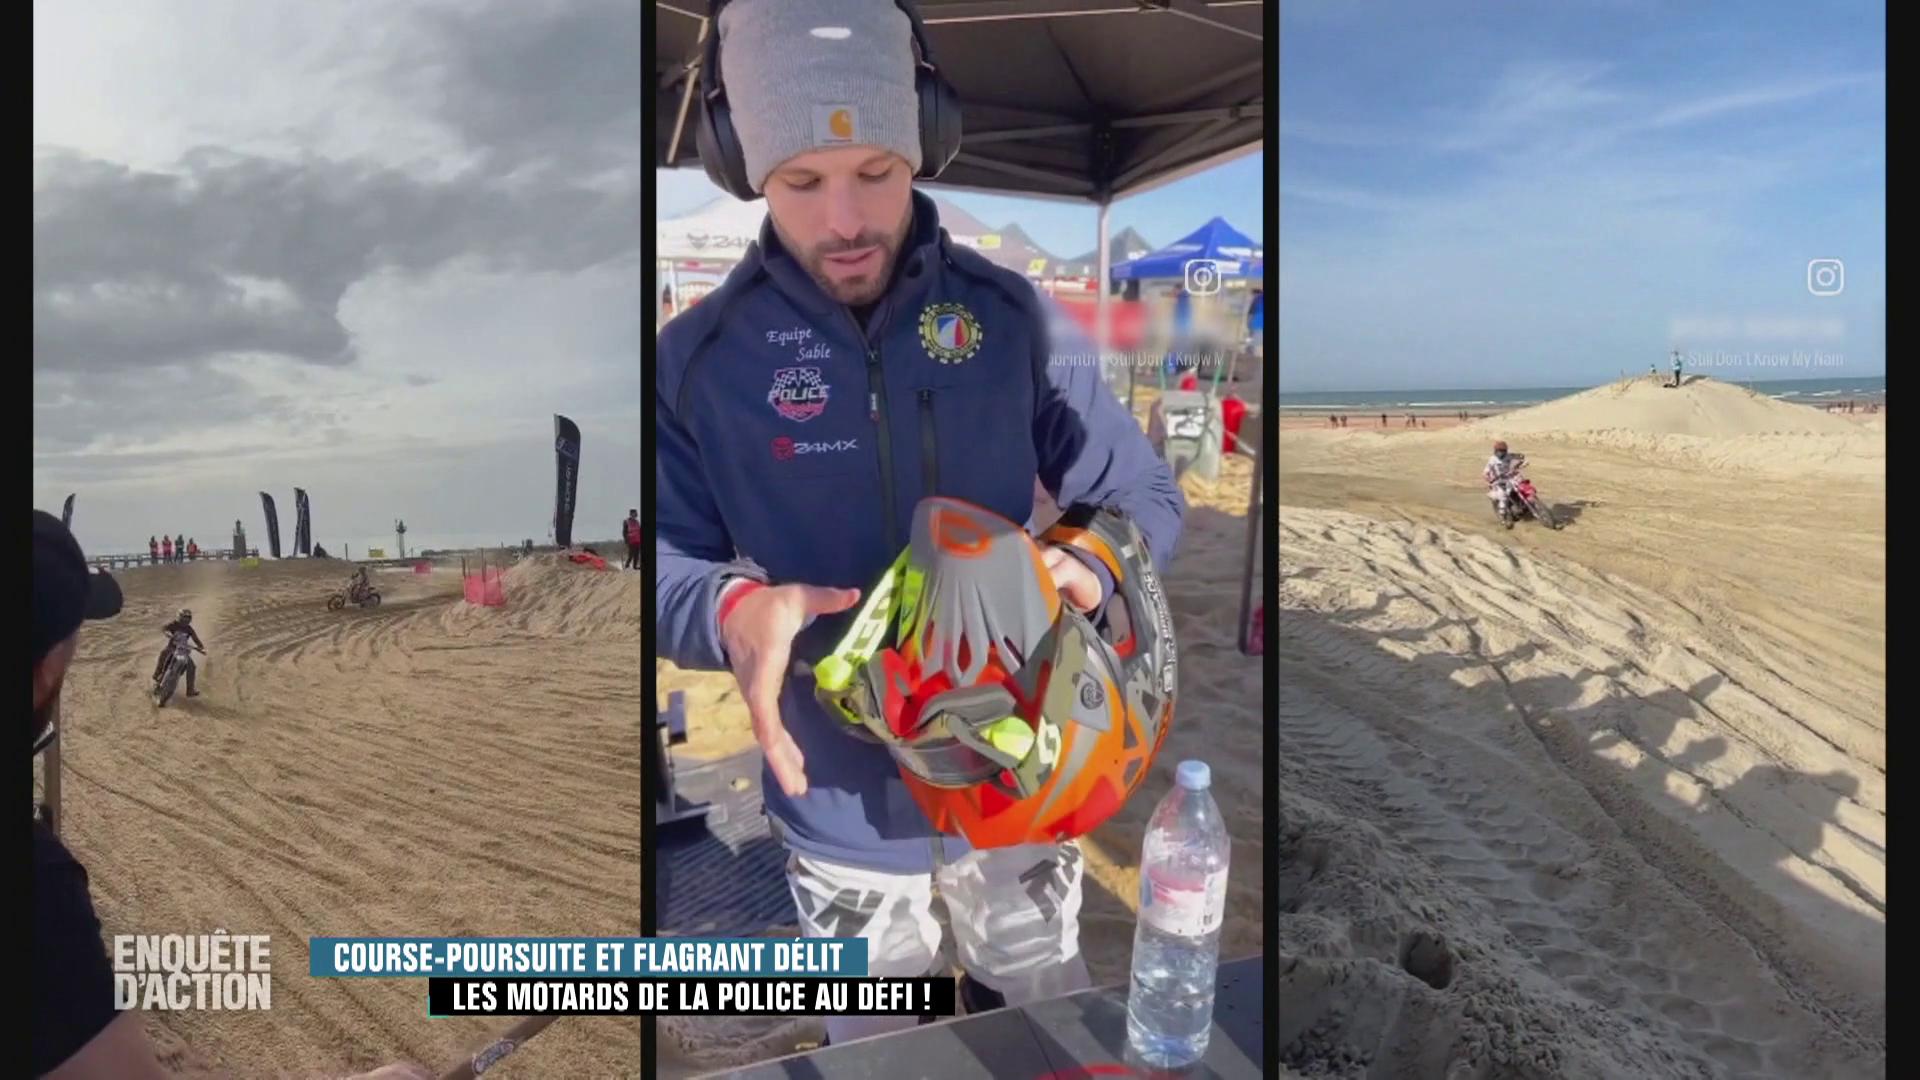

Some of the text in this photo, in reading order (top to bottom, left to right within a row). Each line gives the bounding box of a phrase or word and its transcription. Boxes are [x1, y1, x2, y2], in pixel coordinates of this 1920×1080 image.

[766, 327, 813, 347] Equipe
[795, 343, 832, 362] Sable
[767, 384, 831, 404] POLICE
[793, 439, 858, 455] 24MX
